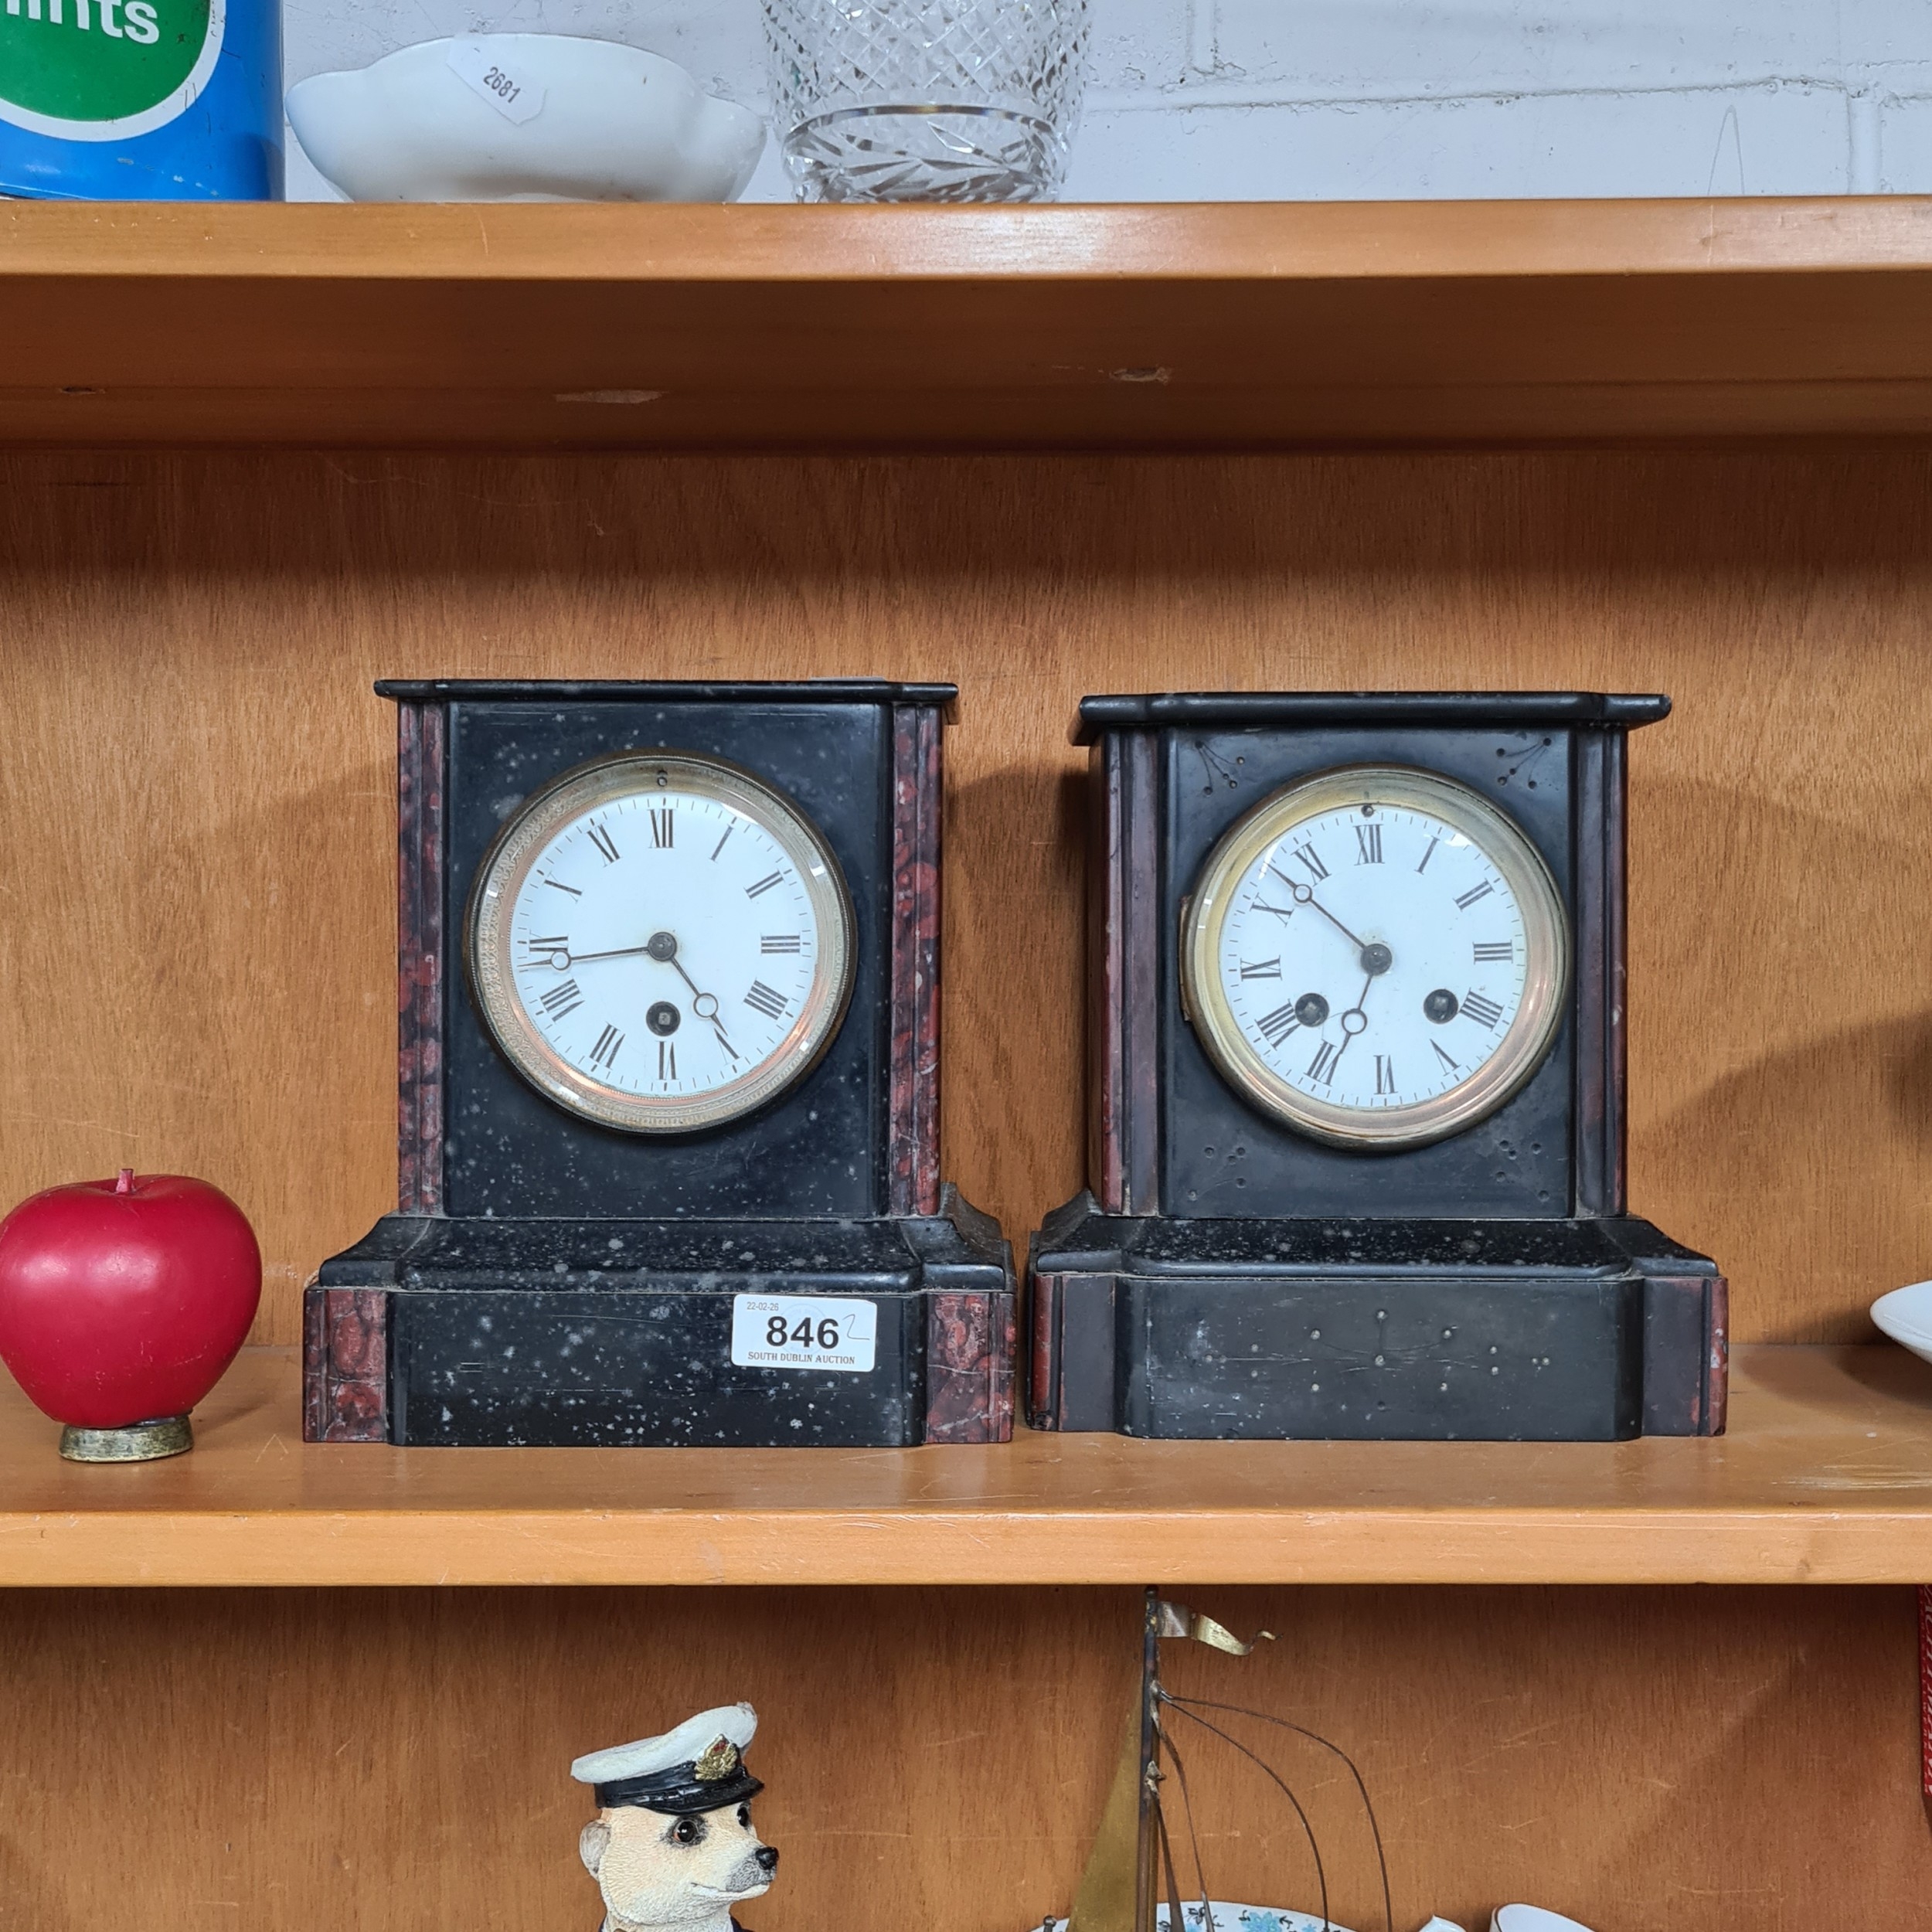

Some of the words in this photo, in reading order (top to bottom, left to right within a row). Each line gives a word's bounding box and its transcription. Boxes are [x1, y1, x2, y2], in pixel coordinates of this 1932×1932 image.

[483, 66, 521, 104] 2681
[587, 822, 623, 868] XI
[647, 808, 676, 849] XII
[709, 824, 734, 862] I
[1352, 824, 1385, 866] XII
[1290, 841, 1332, 887] XI
[1415, 835, 1440, 876] I
[543, 872, 583, 903] X
[743, 869, 786, 900] II
[1453, 878, 1495, 912] II
[1250, 892, 1294, 928] X
[529, 929, 569, 955] IX
[760, 935, 801, 954] III
[1473, 940, 1513, 964] III
[1240, 954, 1283, 981] IX
[539, 978, 585, 1022] VIII
[743, 980, 790, 1021] IIII
[1458, 987, 1505, 1032] IIII
[1254, 998, 1301, 1051] VIII
[589, 1021, 625, 1070] VII
[655, 1041, 679, 1080] VI
[713, 1027, 740, 1066] V
[1303, 1039, 1341, 1087] VII
[1429, 1038, 1461, 1077] V
[1373, 1054, 1398, 1095] VI
[747, 1301, 779, 1311] 22-02-26
[766, 1315, 839, 1349] 846
[747, 1351, 777, 1362] SOUTH
[780, 1353, 813, 1363] DUBLIN
[815, 1355, 855, 1365] AUCTION
